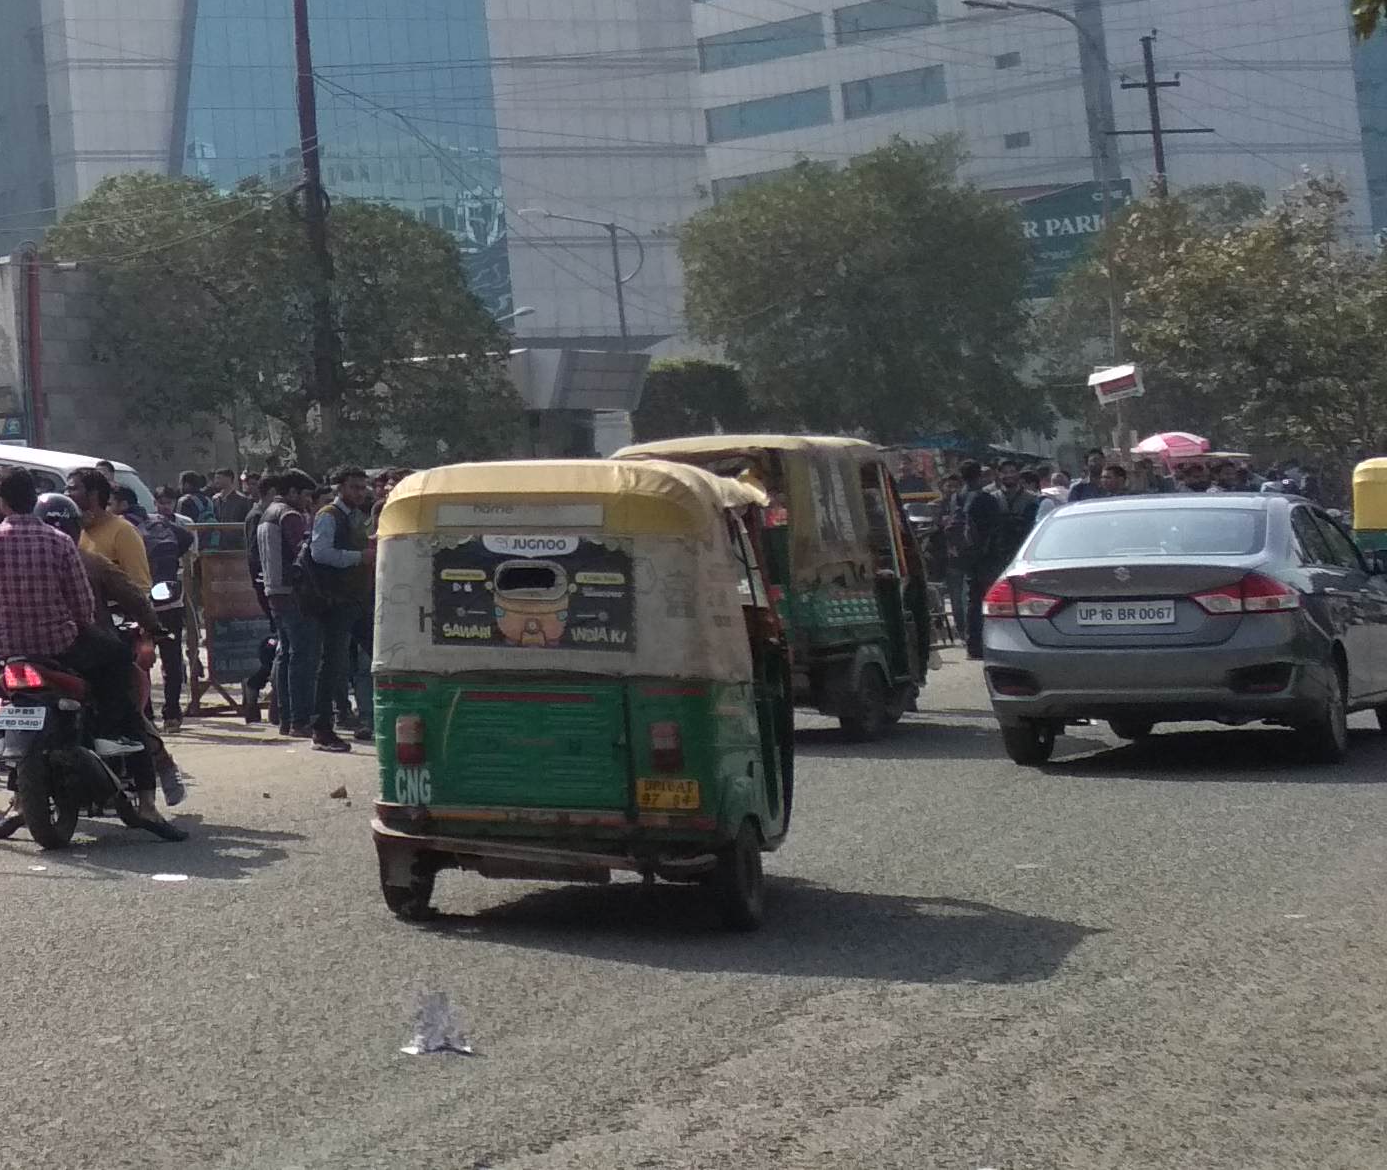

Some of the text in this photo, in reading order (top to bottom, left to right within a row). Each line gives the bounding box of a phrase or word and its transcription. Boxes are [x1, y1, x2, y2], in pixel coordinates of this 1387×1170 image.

[1079, 606, 1172, 621] UP 16 BR 0067
[395, 768, 432, 806] CNG
